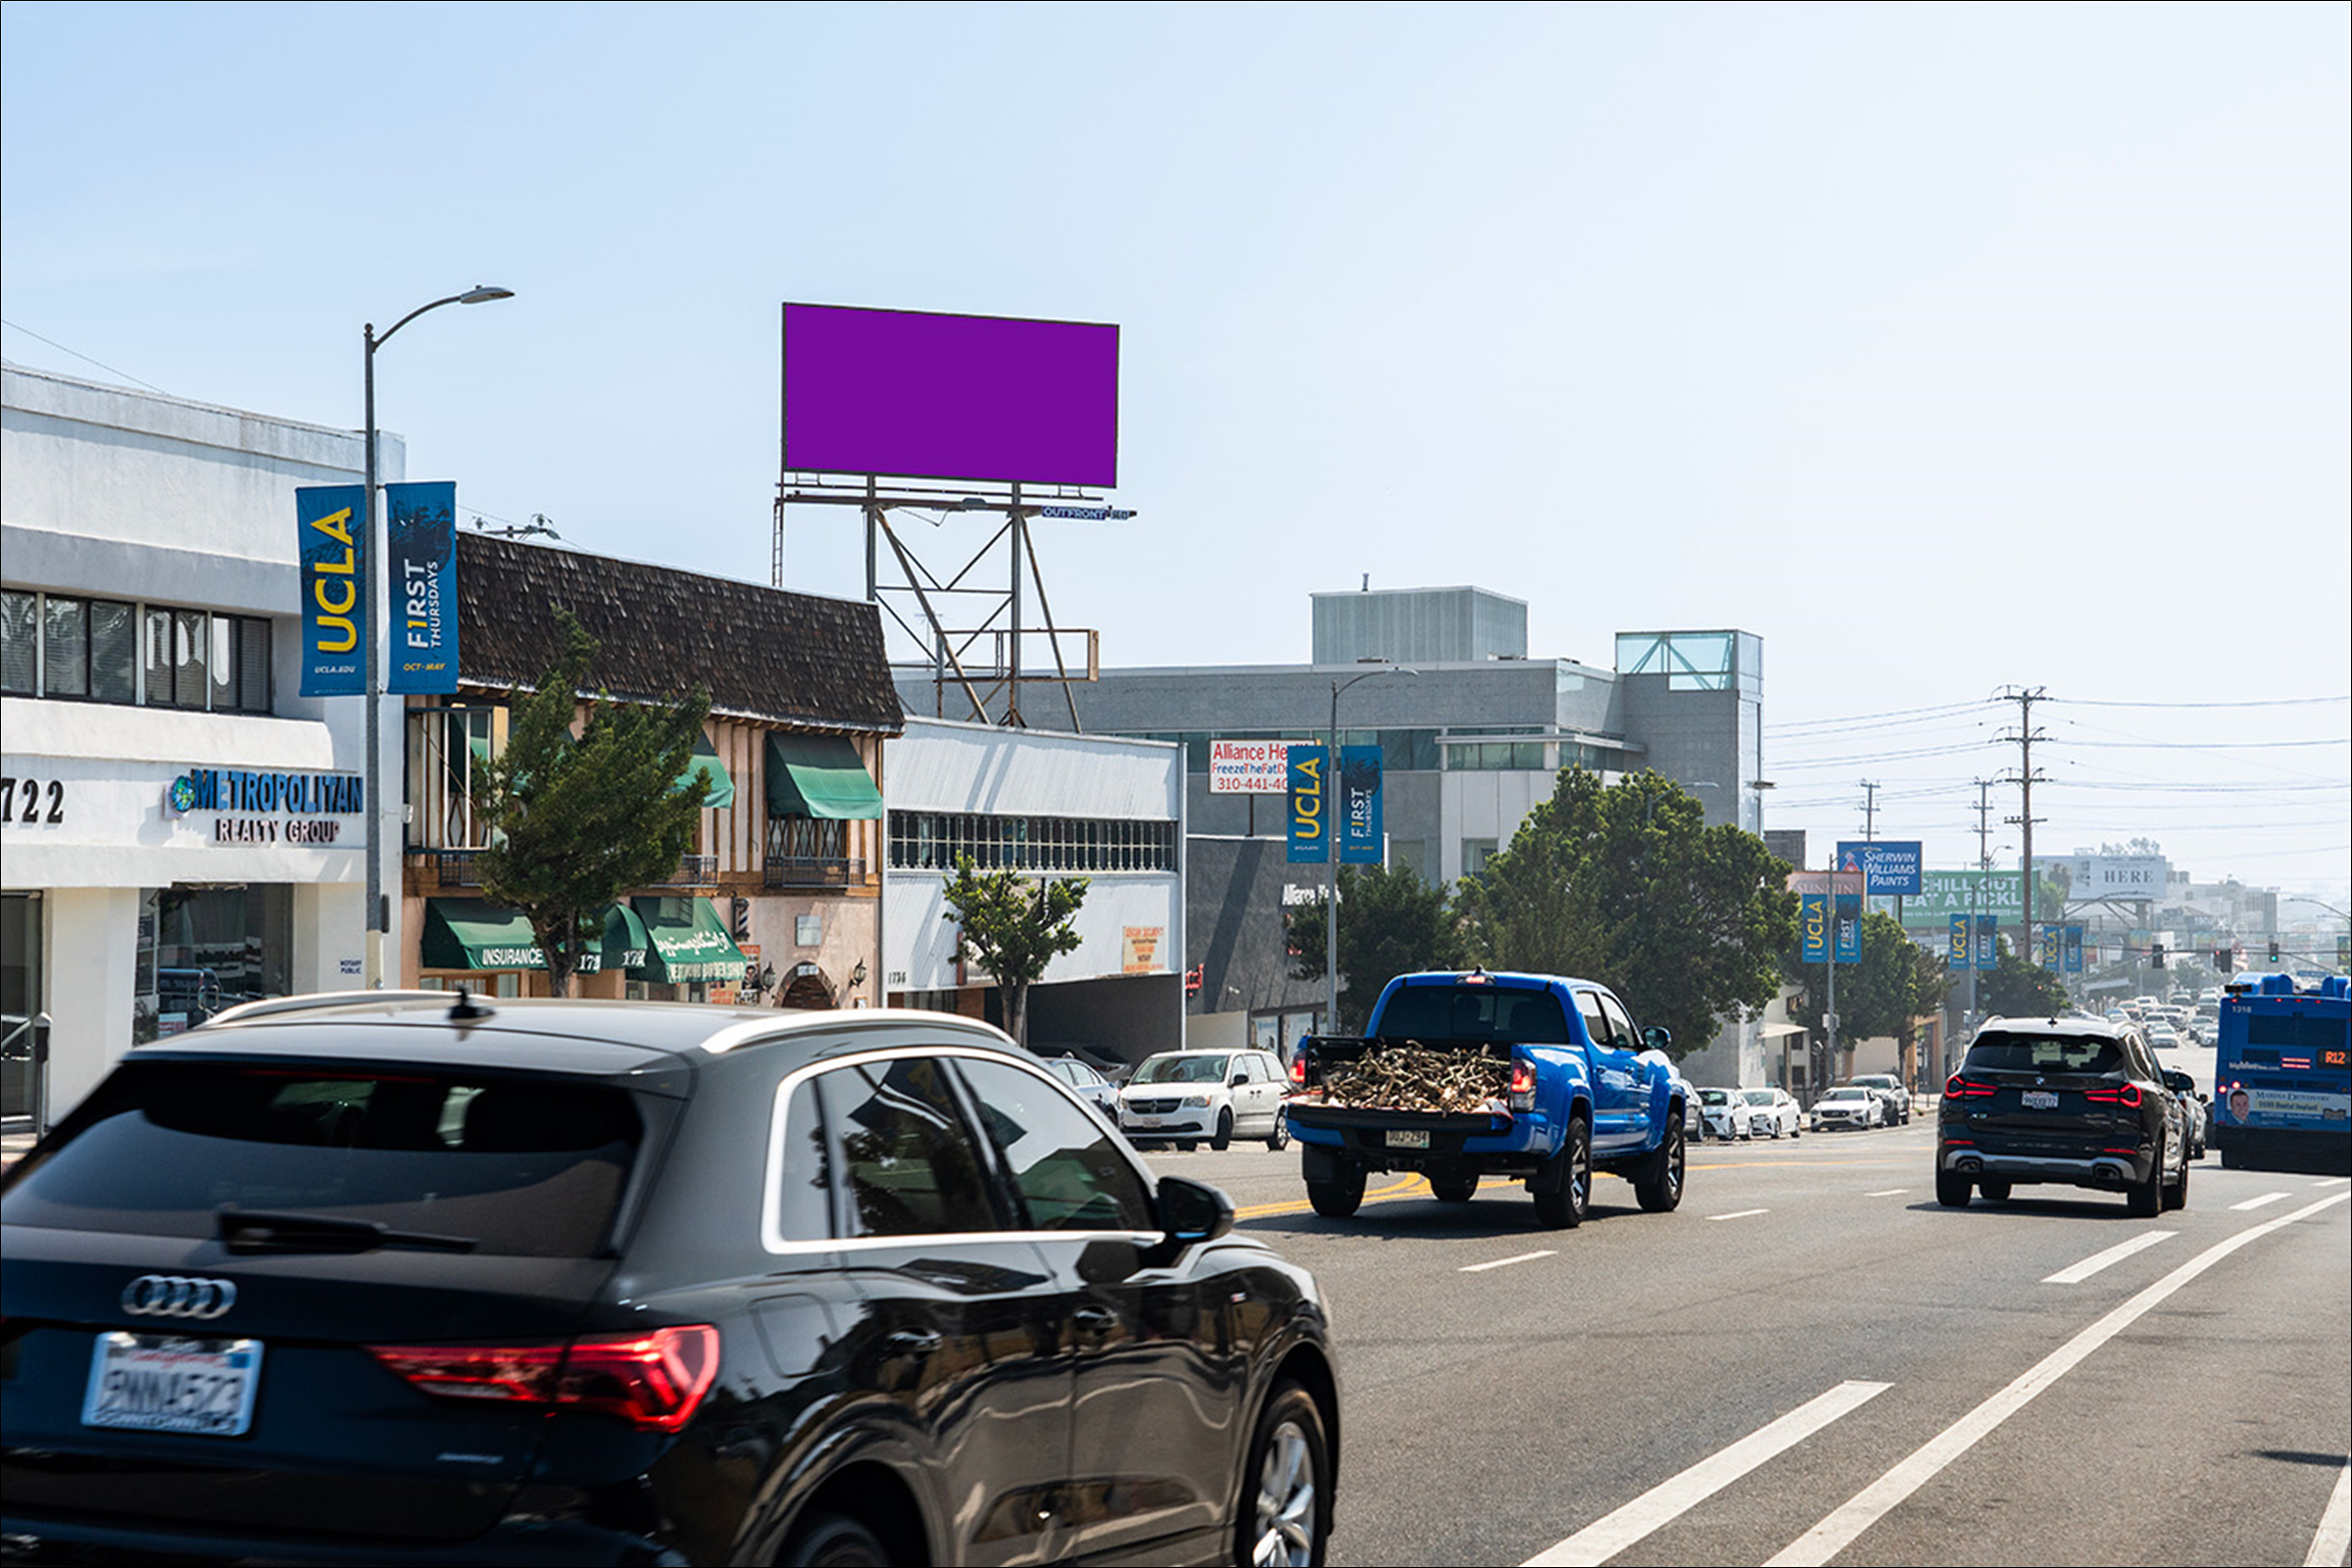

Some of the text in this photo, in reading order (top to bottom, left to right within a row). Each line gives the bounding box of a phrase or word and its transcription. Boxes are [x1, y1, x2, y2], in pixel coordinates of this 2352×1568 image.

[1043, 507, 1105, 519] OUTFRONT
[310, 507, 358, 652] UCLA
[426, 562, 442, 649] THURSDAYS
[1213, 743, 1265, 760] Alliance
[1211, 762, 1288, 774] FreezeTheFatD
[191, 769, 364, 813] METROPOLITAN
[1217, 777, 1288, 791] 310-441-40
[1, 777, 64, 823] 722
[1295, 758, 1321, 839] UCLA
[216, 819, 341, 843] REALTY GROUP
[1864, 851, 1917, 863] SHERWIN
[1863, 863, 1916, 874] WILLIAMS
[2104, 870, 2154, 883] HERE
[1870, 875, 1910, 887] PAINTS
[1978, 876, 2021, 892] OUT
[1901, 893, 1939, 907] EAT
[1944, 893, 1958, 907] A
[1808, 901, 1824, 949] UCLA
[1953, 919, 1968, 958] UCLA
[2045, 930, 2058, 963] UCLA
[482, 948, 543, 965] INSURANCE
[2325, 1051, 2346, 1065] R12
